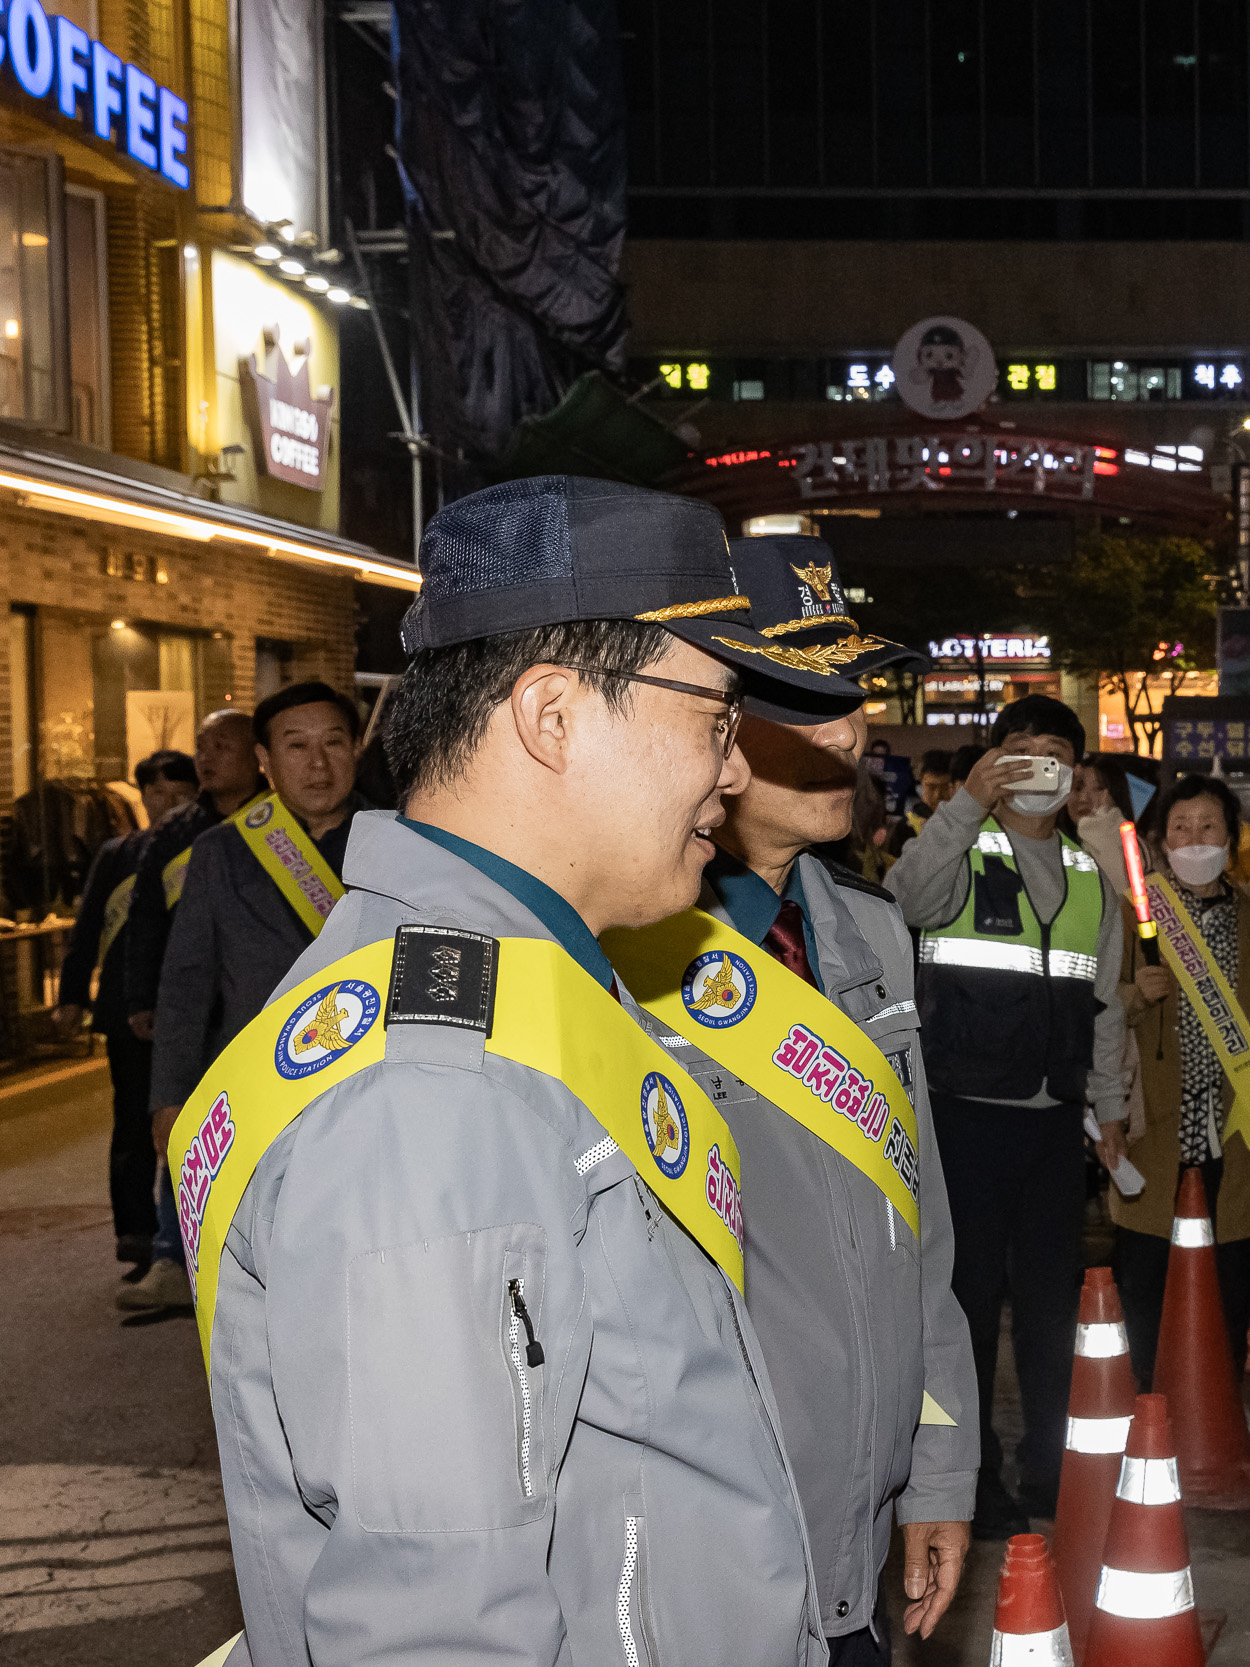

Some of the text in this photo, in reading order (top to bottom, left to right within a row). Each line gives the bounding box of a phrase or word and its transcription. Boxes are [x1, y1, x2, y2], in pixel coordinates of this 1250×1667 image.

[0, 0, 190, 189] OFFEE
[848, 364, 895, 390] 도수
[270, 432, 321, 477] COFFEE
[929, 636, 1051, 658] LOTTERIA
[1218, 1021, 1250, 1058] 거리
[712, 1091, 728, 1101] LEE
[772, 1023, 890, 1143] 범죄없는
[178, 1091, 236, 1308] 범죄없
